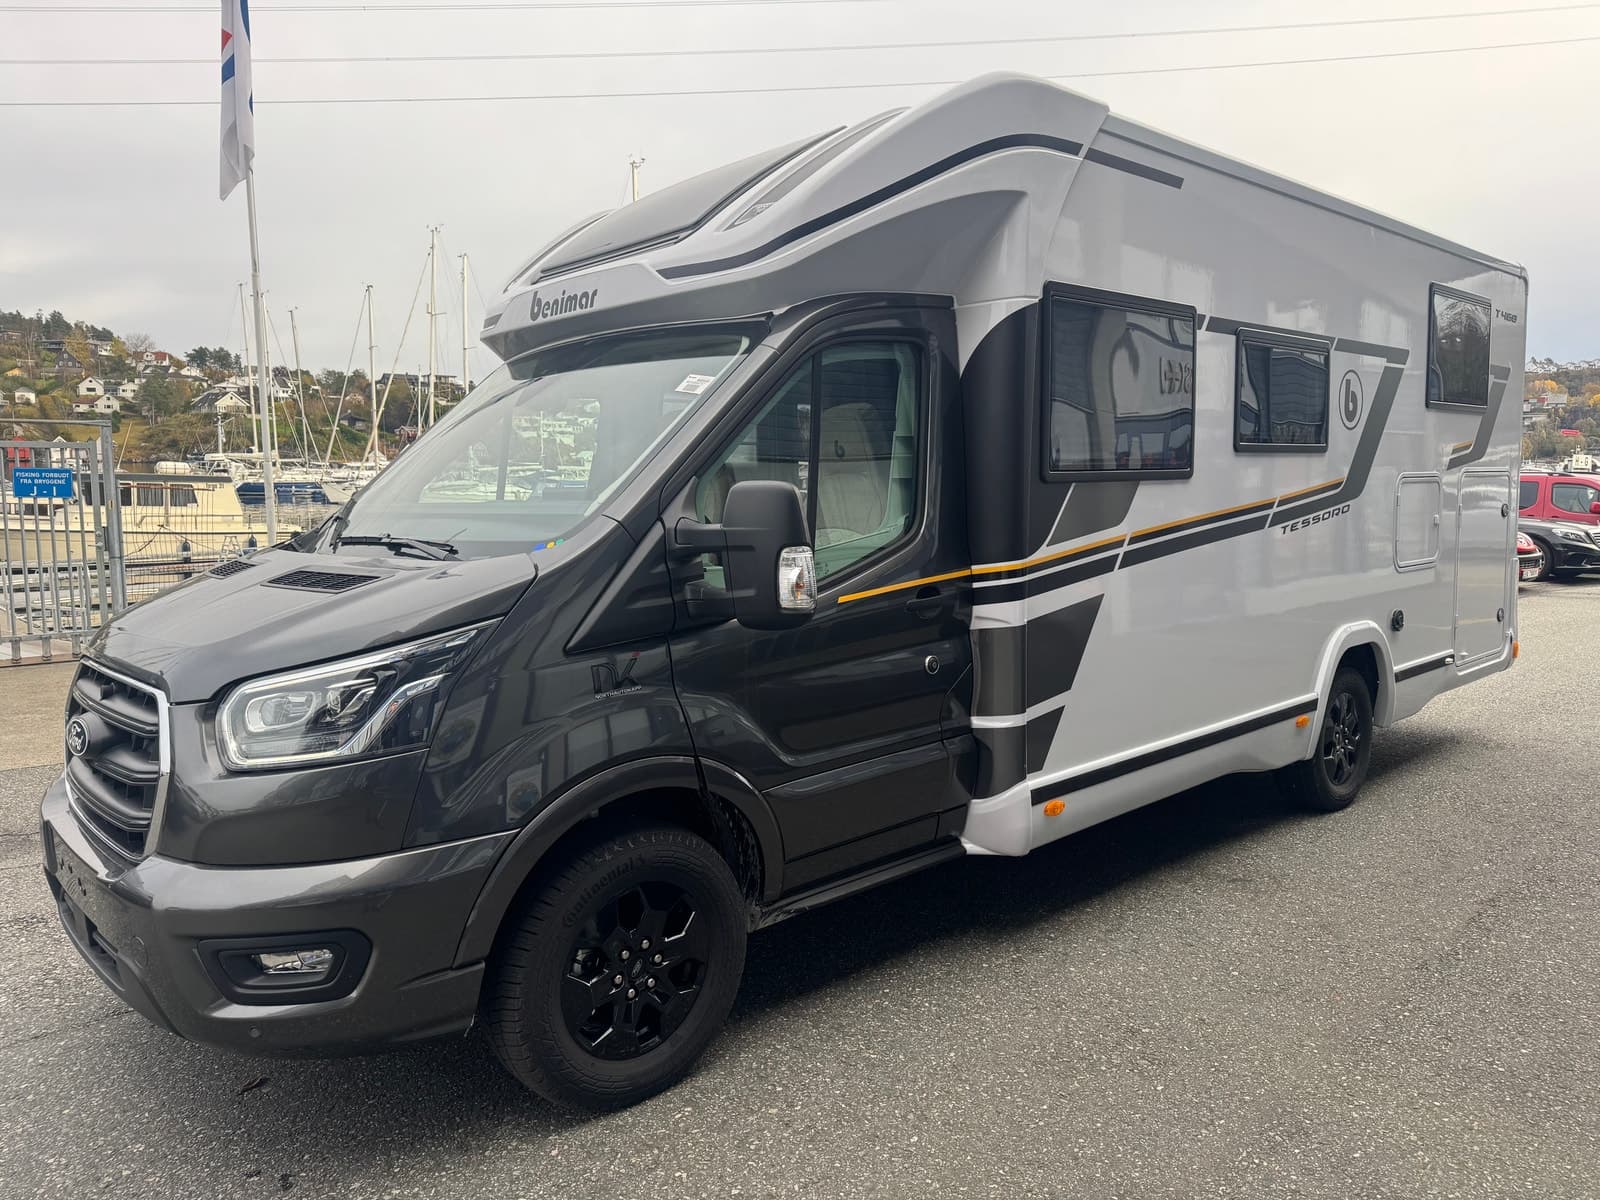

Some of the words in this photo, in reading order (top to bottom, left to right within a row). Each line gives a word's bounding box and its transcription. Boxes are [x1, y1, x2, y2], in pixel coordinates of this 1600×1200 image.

[529, 288, 598, 322] benimar
[1280, 503, 1350, 535] TESSORO
[561, 857, 634, 927] Continental
